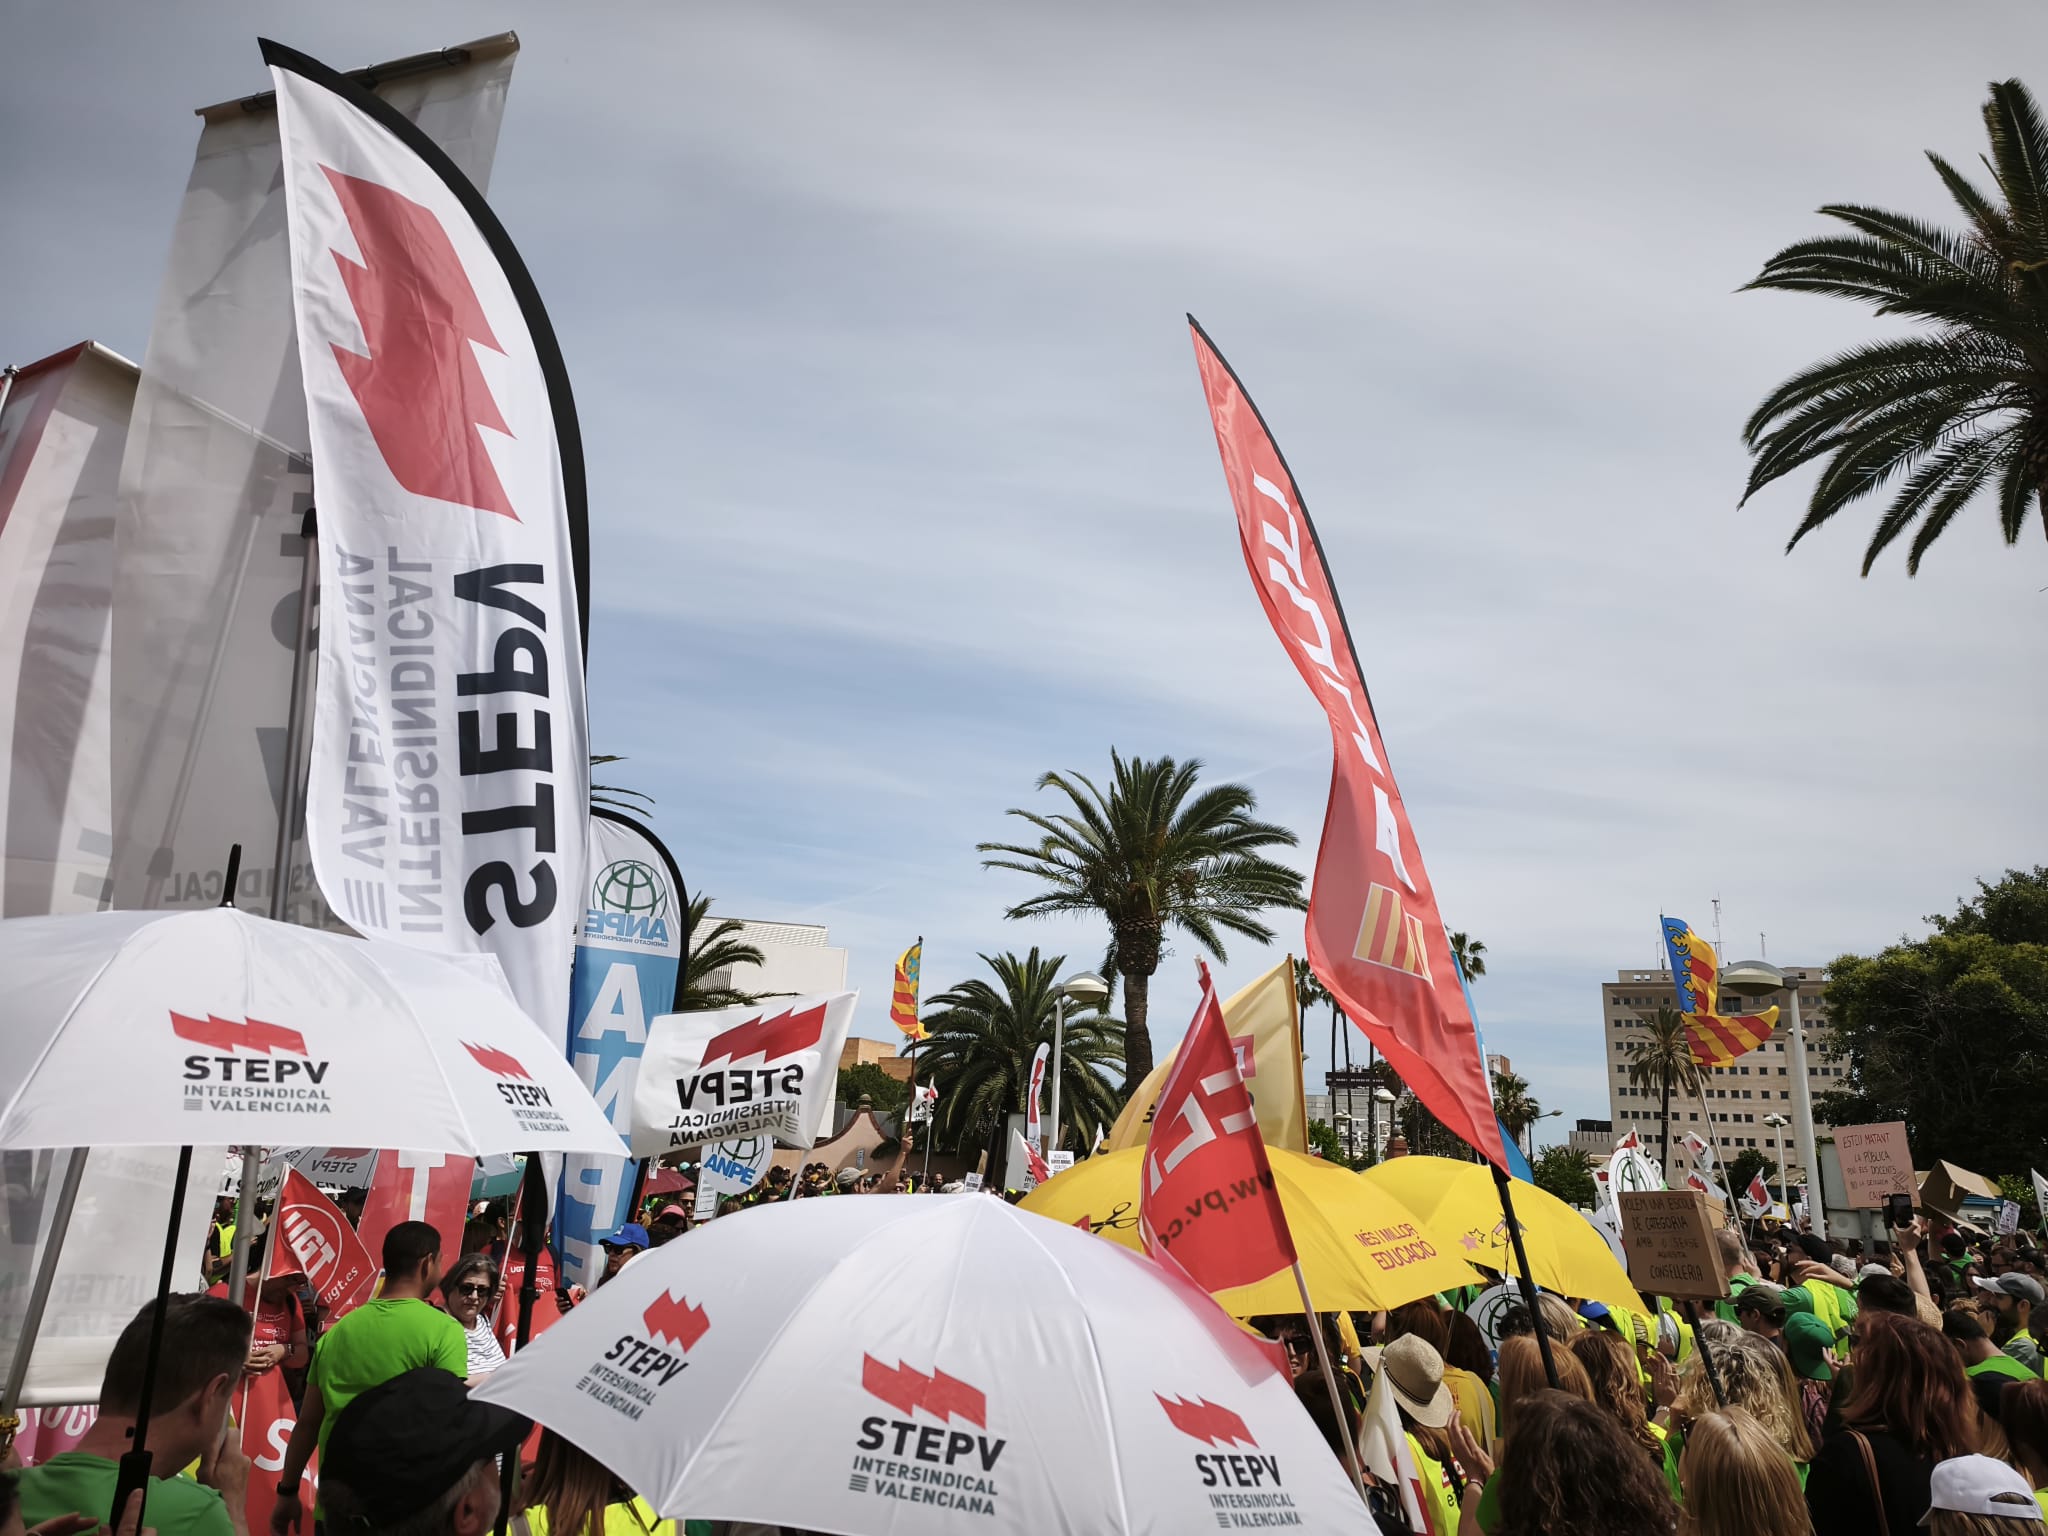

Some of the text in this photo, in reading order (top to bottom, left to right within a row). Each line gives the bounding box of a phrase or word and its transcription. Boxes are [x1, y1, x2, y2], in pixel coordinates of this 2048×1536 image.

[183, 1055, 329, 1084] STEPV
[184, 1085, 331, 1100] INTERSINDICAL
[496, 1083, 552, 1107] STEPV
[210, 1100, 331, 1113] VALENCIANA
[512, 1109, 564, 1121] INTERSINDICAL
[528, 1122, 570, 1132] VALENCIANA
[704, 1154, 756, 1186] ANPE
[1632, 1216, 1642, 1231] DE
[1636, 1238, 1654, 1248] AMB
[324, 1266, 358, 1304] ugt.es
[1650, 1264, 1704, 1281] CONSELLERIA
[605, 1336, 689, 1387] STEPV
[589, 1362, 656, 1406] INTERSINDICAL
[587, 1381, 644, 1421] VALENCIANA
[856, 1416, 1007, 1471] STEPV
[853, 1455, 998, 1495] INTERSINDICAL
[1195, 1454, 1281, 1487] STEPV
[875, 1479, 995, 1516] VALENCIANA
[1209, 1493, 1295, 1508] INTERSINDICAL
[1230, 1511, 1303, 1528] VALENCIANA
